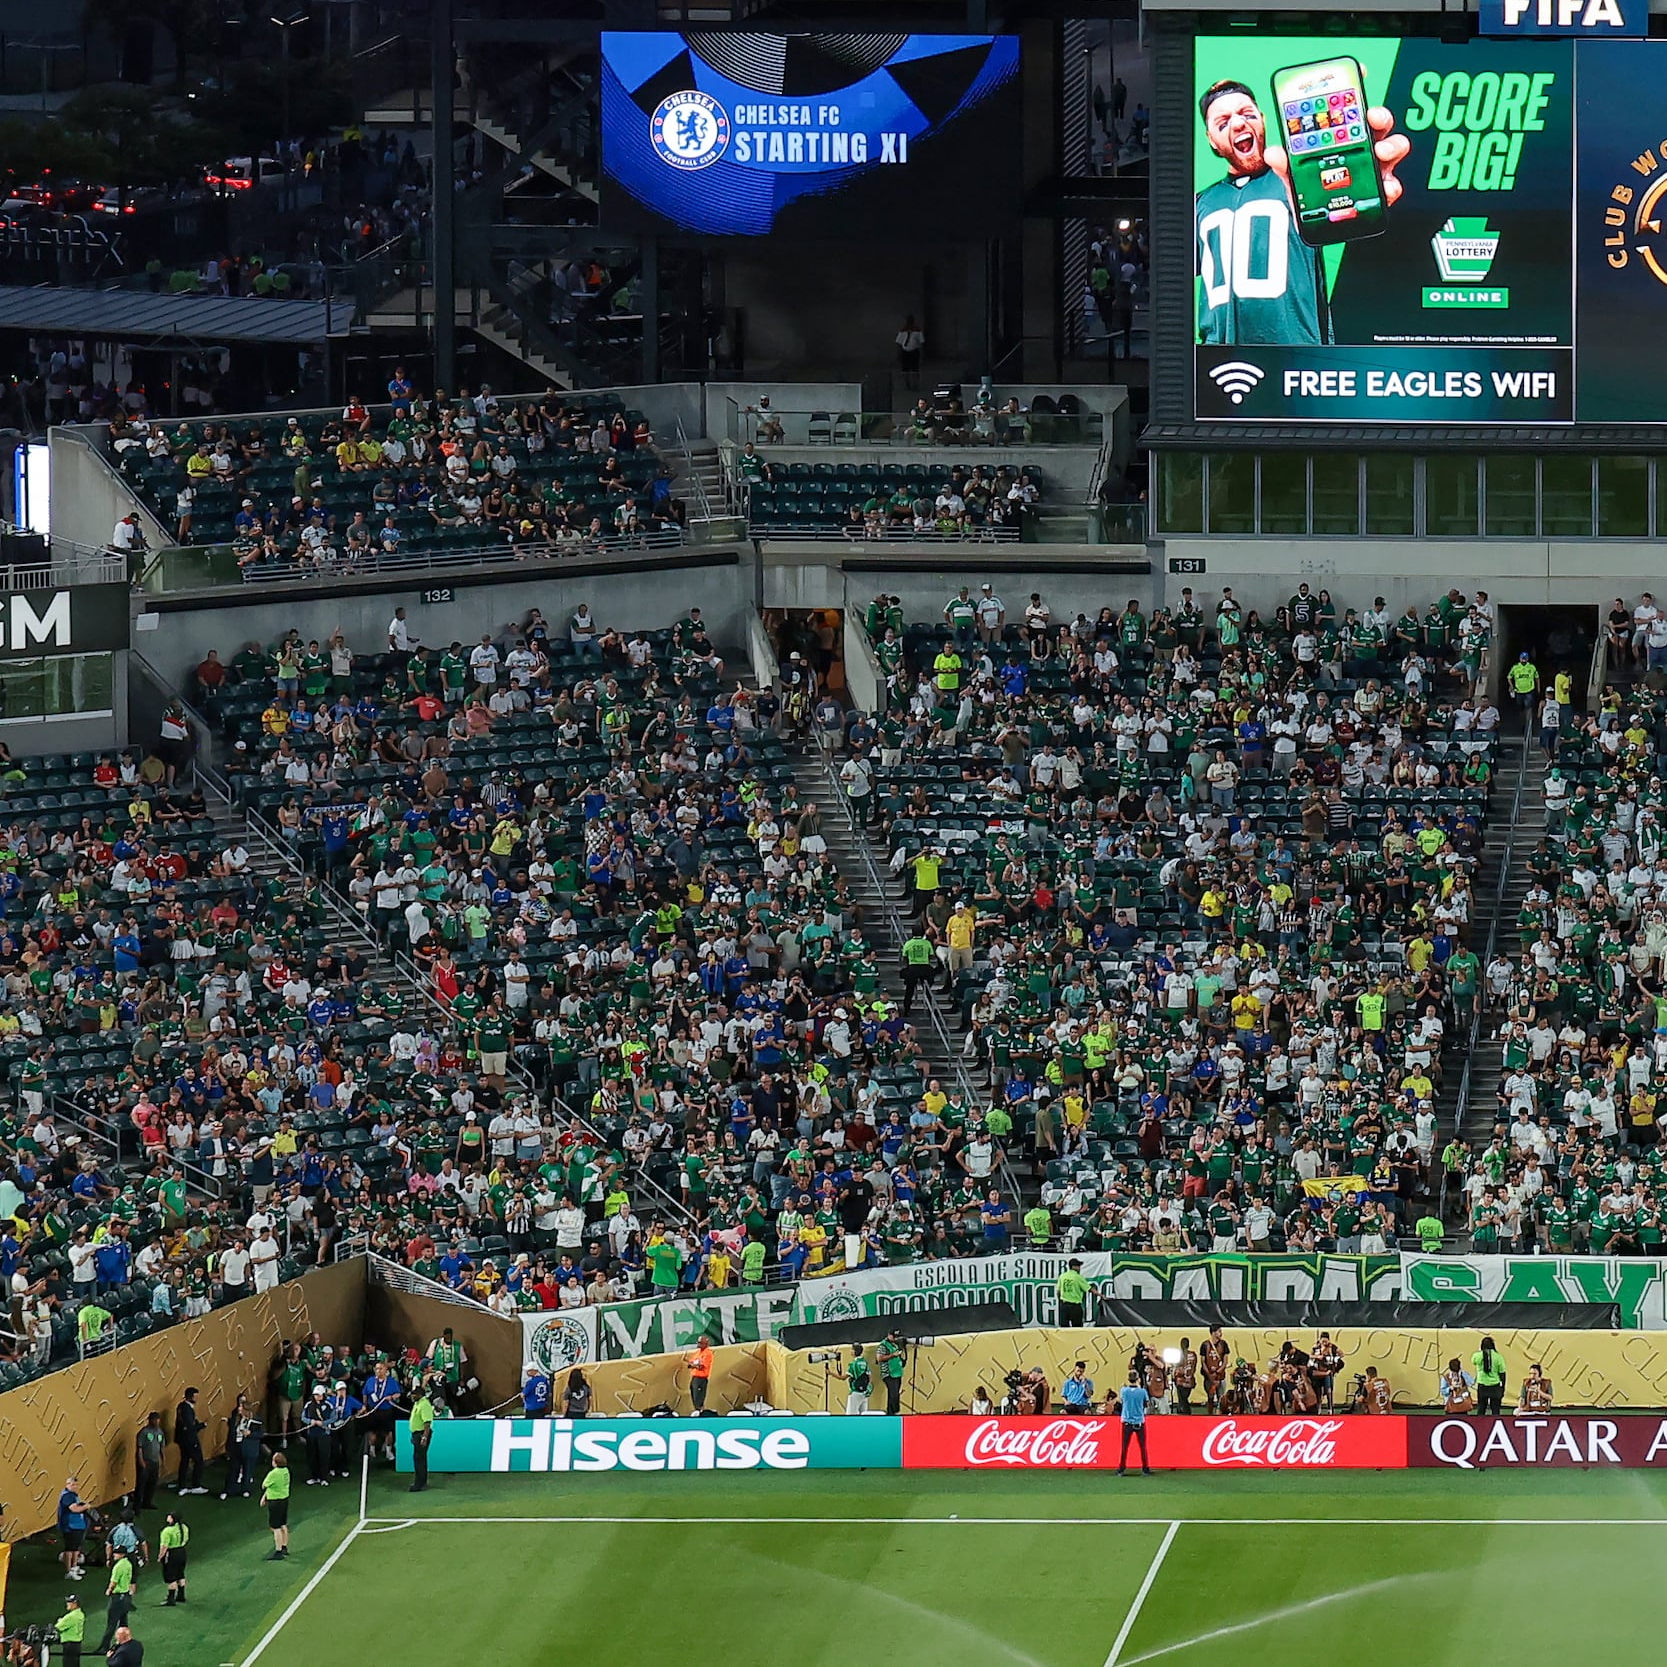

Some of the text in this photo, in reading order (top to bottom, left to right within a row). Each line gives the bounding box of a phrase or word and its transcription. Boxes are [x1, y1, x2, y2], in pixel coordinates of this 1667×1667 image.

[663, 94, 716, 111] CHELSEA
[735, 105, 840, 126] CHELSEA FC
[1405, 71, 1555, 132] SCORE
[735, 132, 907, 163] STARTING XI
[1427, 132, 1523, 191] BIG!
[1604, 184, 1634, 269] CLUB
[1446, 248, 1493, 256] LOTTERY
[1430, 292, 1501, 303] ONLINE
[1284, 370, 1555, 398] FREE EAGLES WIFI
[1175, 560, 1200, 572] 131
[424, 589, 451, 603] 132
[914, 1257, 1069, 1288] ESCOLA DE SAMB
[490, 1418, 810, 1471] Hisense
[965, 1418, 1105, 1467] Coca-Cola
[1202, 1418, 1345, 1467] Coca-Cola
[1430, 1419, 1621, 1469] QATAR
